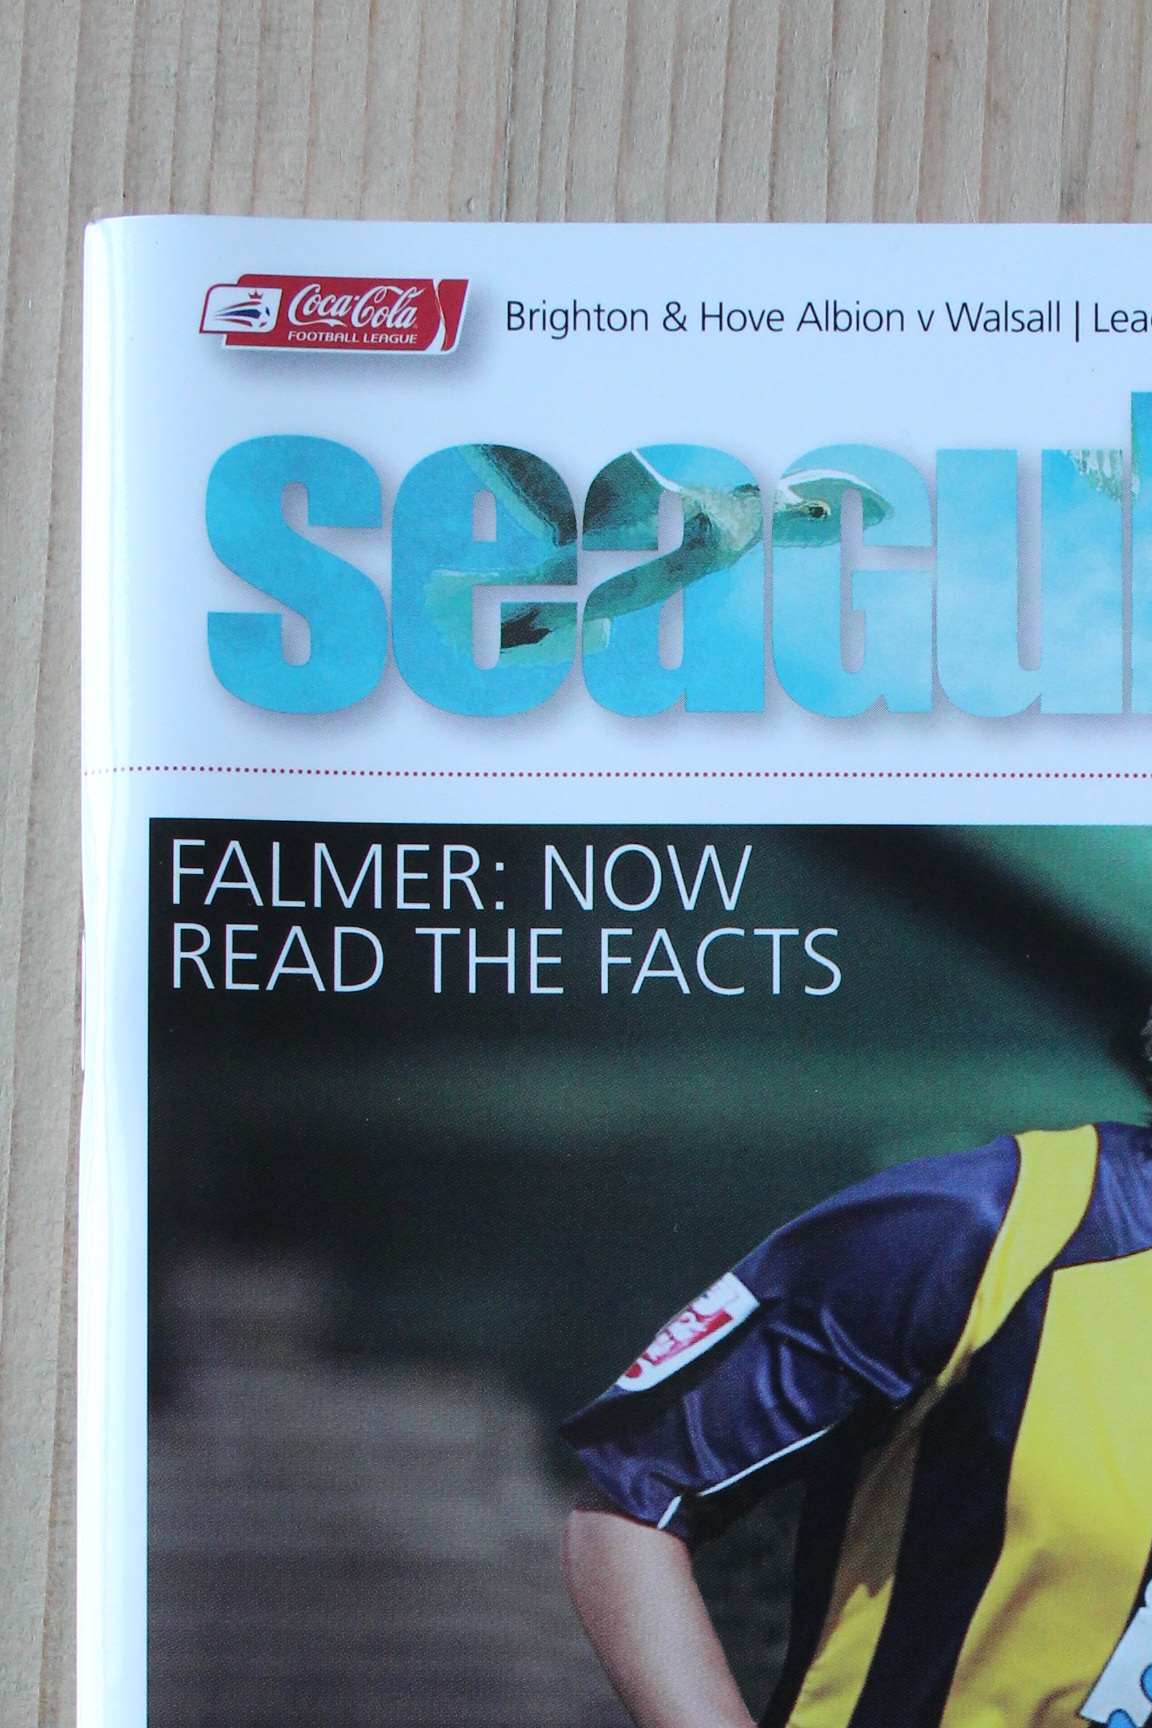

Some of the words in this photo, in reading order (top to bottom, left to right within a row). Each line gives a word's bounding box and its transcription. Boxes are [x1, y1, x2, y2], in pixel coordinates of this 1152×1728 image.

[288, 283, 425, 329] Coca-Cola
[507, 299, 649, 340] Brighton
[663, 301, 688, 333] &
[701, 301, 785, 333] Hove
[797, 300, 904, 333] Albion
[917, 310, 935, 333] v
[946, 301, 1061, 333] Walsall
[288, 330, 359, 343] FOOTBALL
[363, 333, 417, 345] LEAGUE
[171, 838, 505, 911] FALMER:
[544, 842, 753, 912] NOW
[172, 922, 385, 993] READ
[415, 927, 564, 995] THE
[600, 926, 842, 996] FACTS
